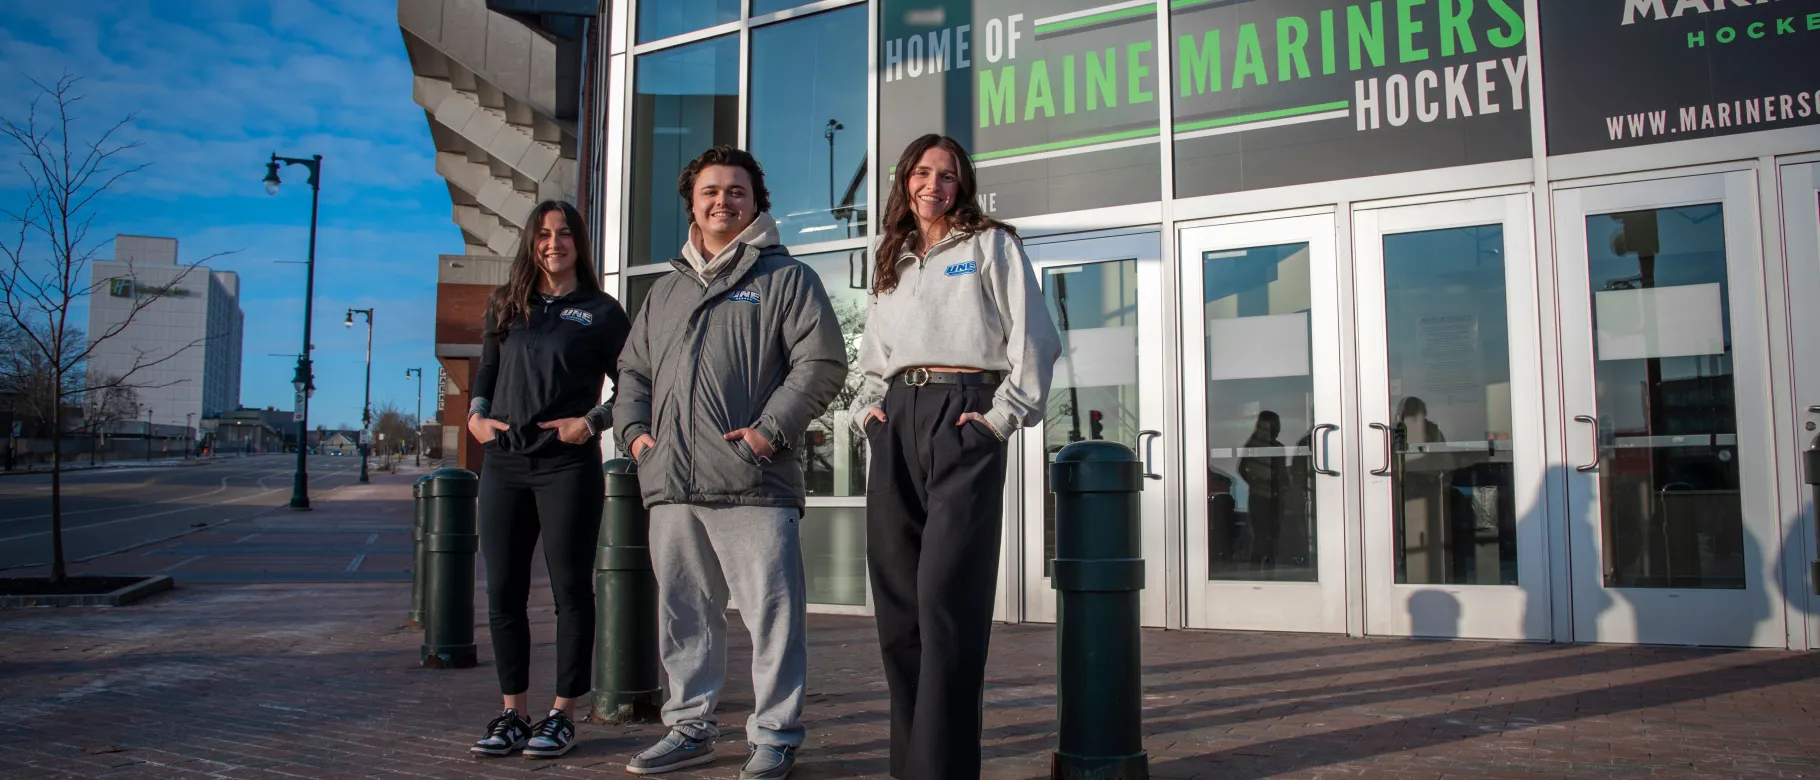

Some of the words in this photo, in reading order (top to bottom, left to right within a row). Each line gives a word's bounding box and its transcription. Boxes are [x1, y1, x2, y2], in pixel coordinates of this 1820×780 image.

[885, 24, 971, 83] HOME
[985, 13, 1024, 63] OF
[979, 40, 1154, 128] MAINE
[1178, 0, 1526, 98] MARINERS
[1354, 55, 1528, 131] HOCKEY
[946, 261, 977, 274] UNE
[561, 308, 592, 322] UNE
